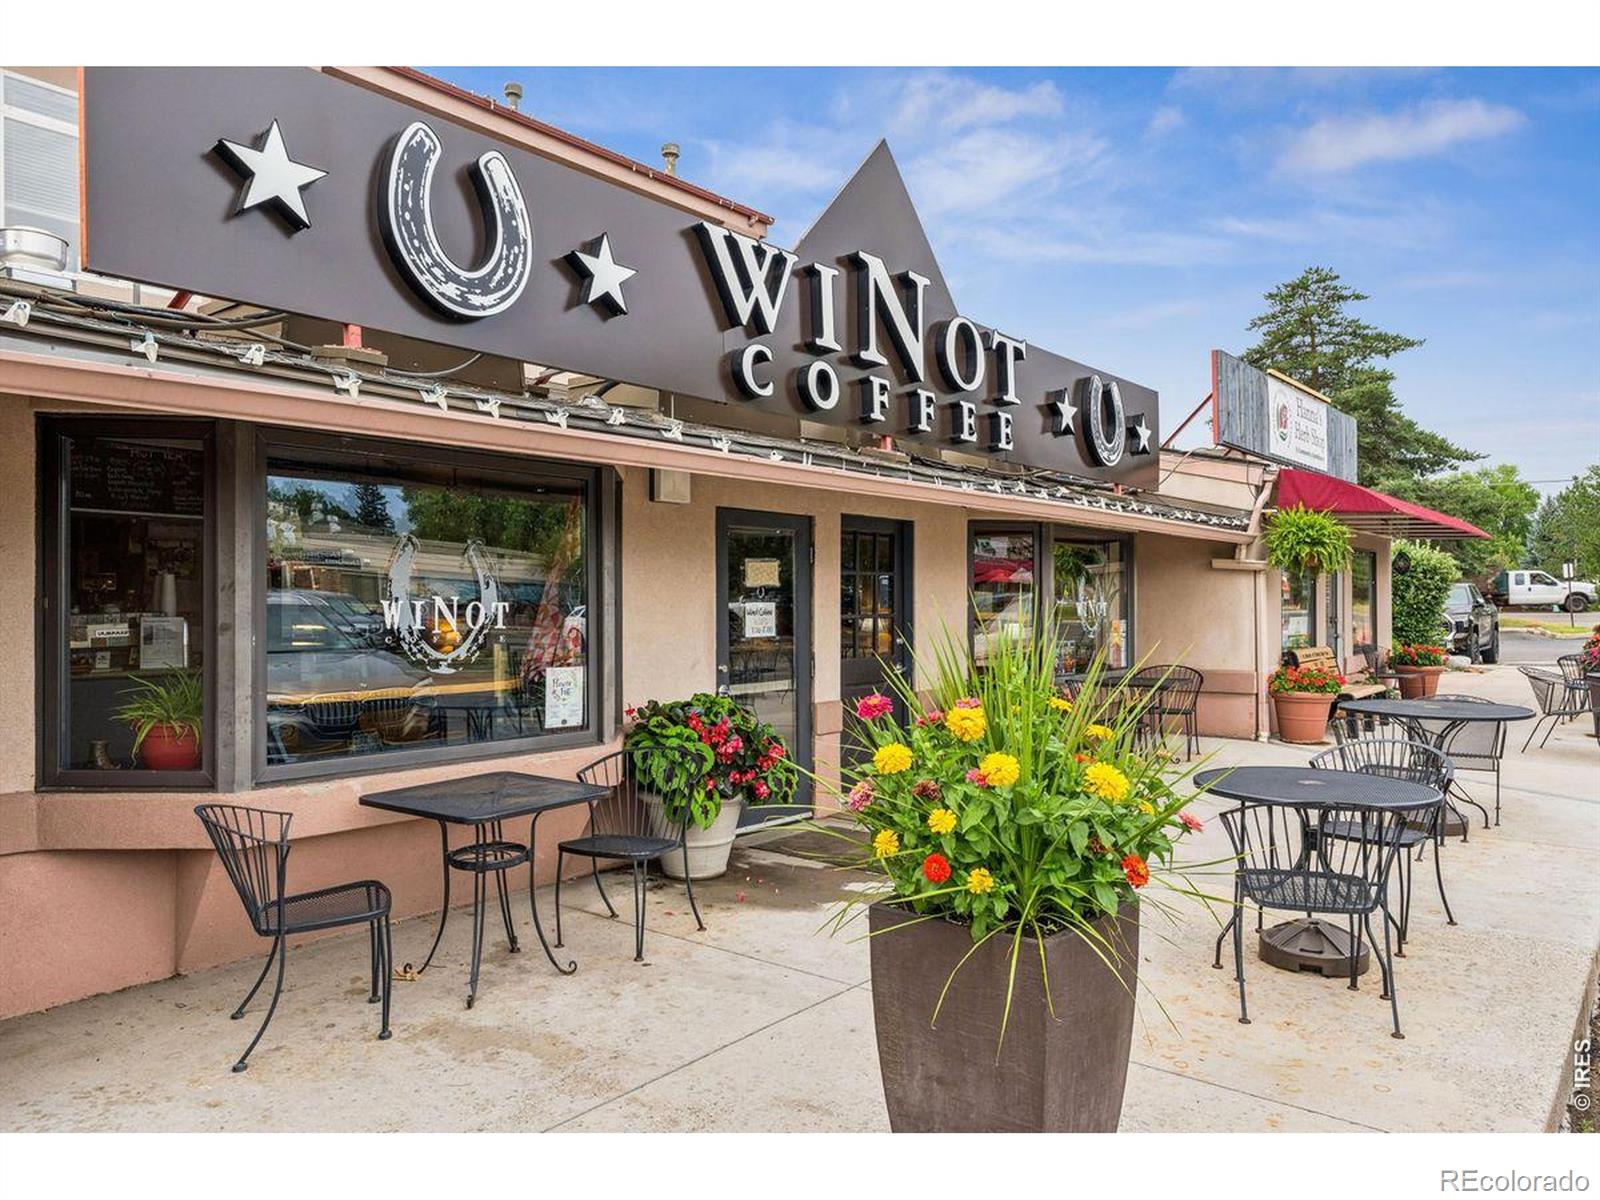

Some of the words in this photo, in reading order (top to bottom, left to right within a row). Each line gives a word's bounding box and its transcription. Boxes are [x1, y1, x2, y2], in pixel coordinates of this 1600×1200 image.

[692, 221, 1026, 407] WINOT
[731, 344, 1014, 450] COFFEE
[380, 595, 510, 634] WINOT
